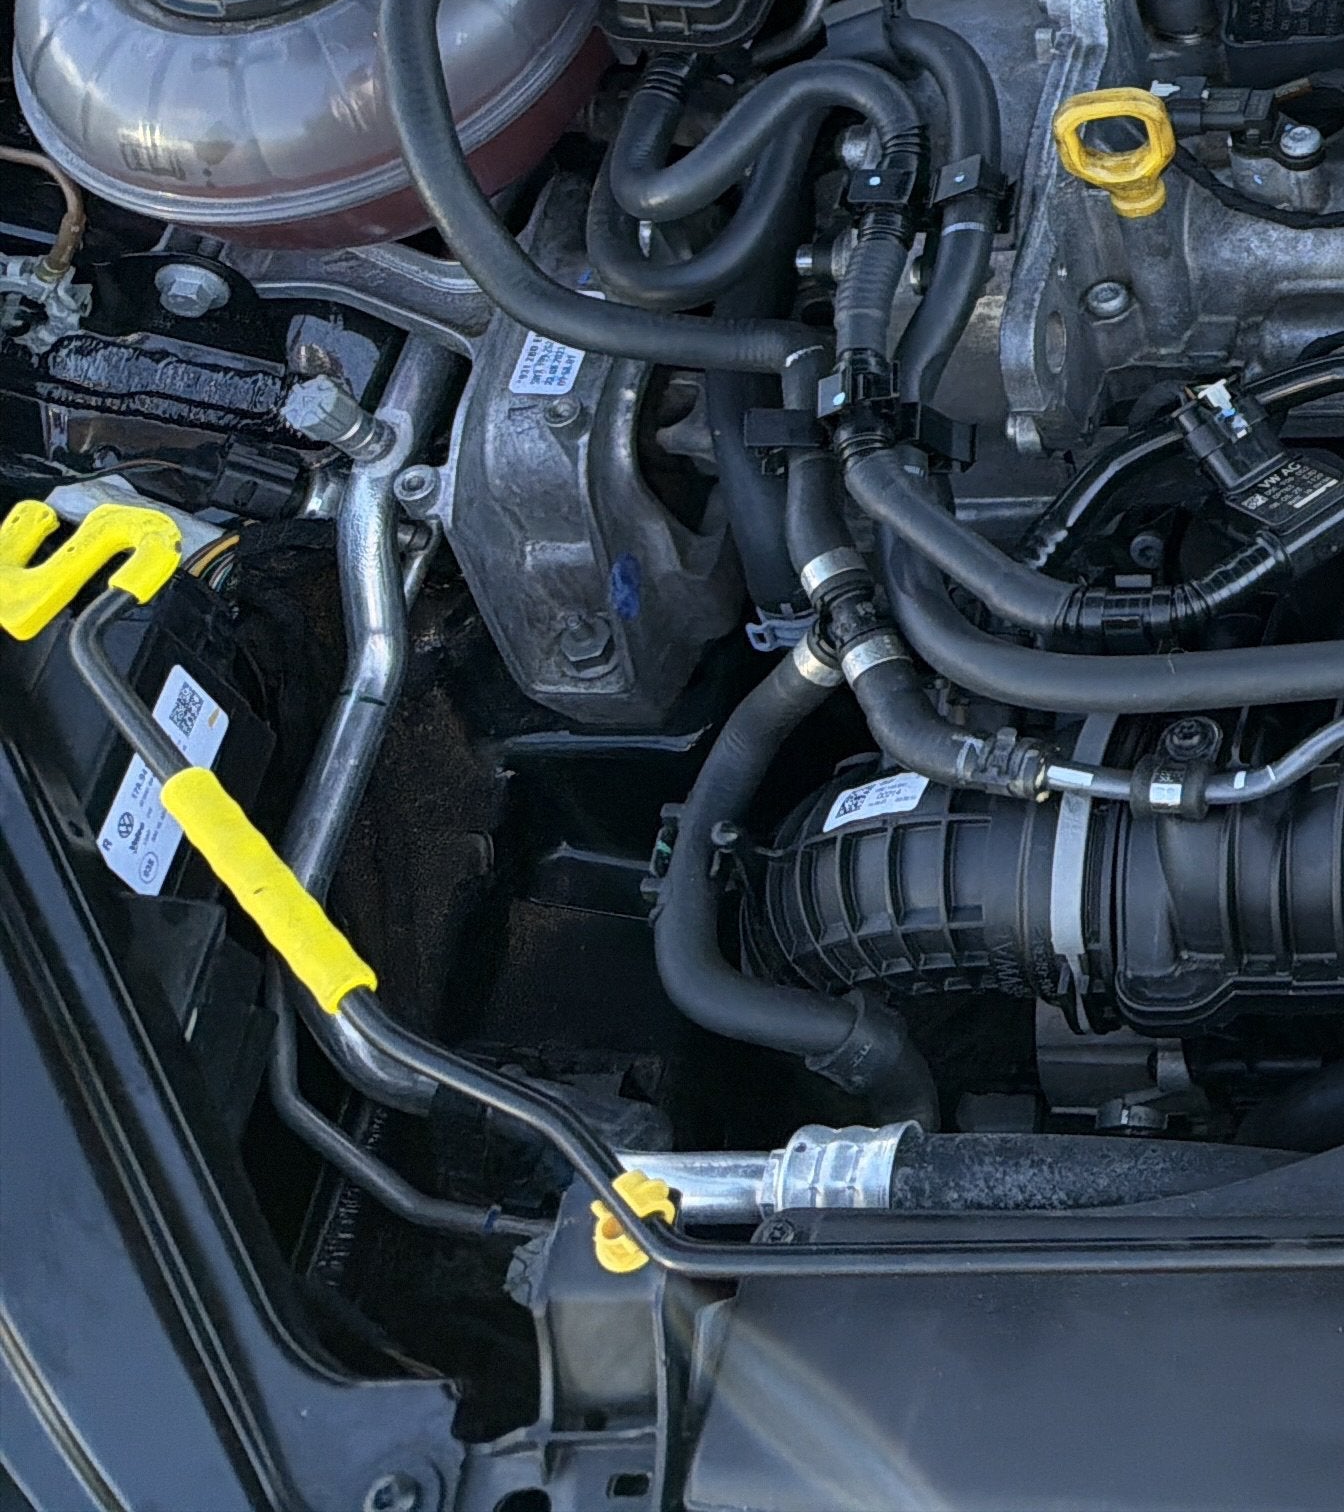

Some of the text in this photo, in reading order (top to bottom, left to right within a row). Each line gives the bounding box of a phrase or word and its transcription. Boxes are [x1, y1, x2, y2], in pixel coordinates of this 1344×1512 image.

[1256, 459, 1301, 492] VW AG
[99, 837, 114, 851] R
